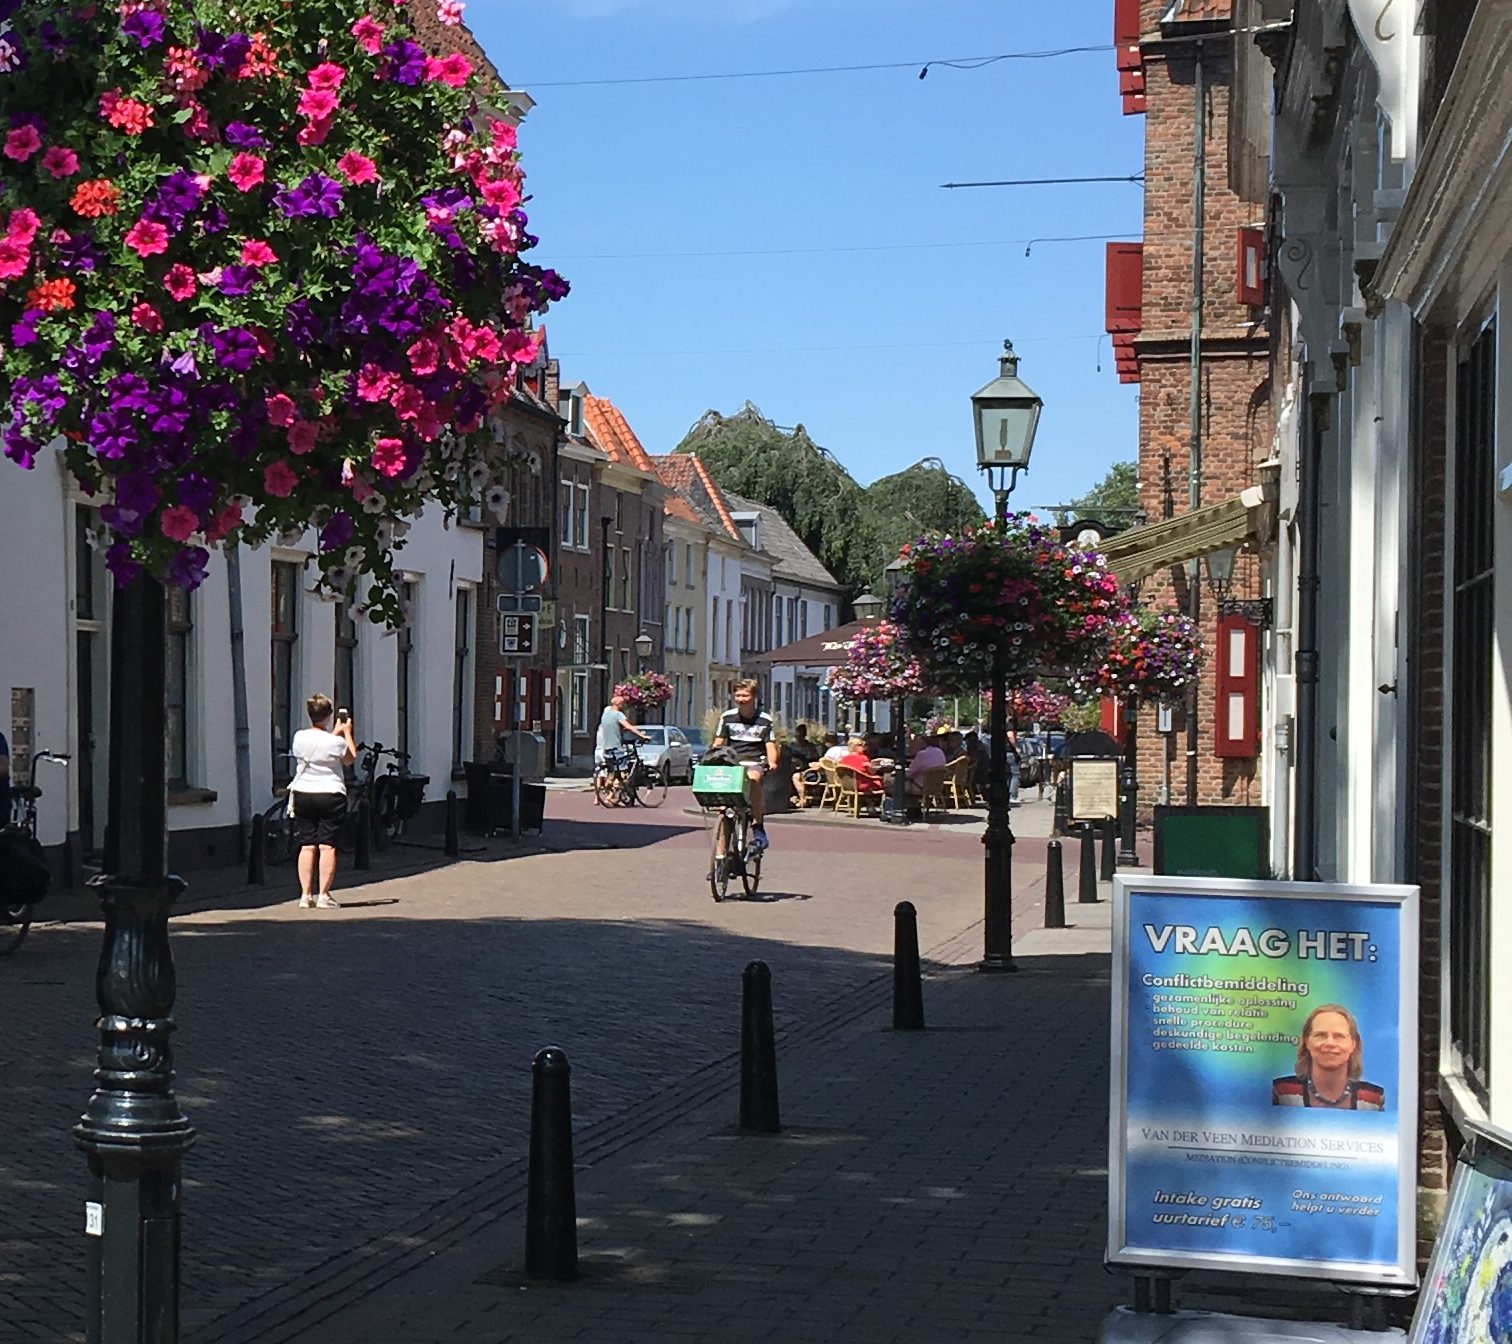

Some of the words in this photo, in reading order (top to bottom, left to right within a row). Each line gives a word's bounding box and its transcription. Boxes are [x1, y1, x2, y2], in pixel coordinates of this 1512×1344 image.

[1143, 924, 1291, 958] VRAAG
[1297, 929, 1379, 962] HET:
[1142, 973, 1310, 995] Conflictbemiddeling
[1153, 993, 1235, 1005] gezamenlijke
[1239, 997, 1297, 1009] oplossing
[1153, 1005, 1198, 1015] behoud
[1203, 1008, 1225, 1017] van
[1228, 1007, 1269, 1018] relatie
[1153, 1016, 1187, 1026] snelle
[1191, 1018, 1254, 1030] procedure
[1153, 1028, 1223, 1041] deskundige
[1226, 1030, 1299, 1045] begeleiding
[1153, 1040, 1208, 1051] gedeelde
[1212, 1042, 1253, 1053] kosten
[1141, 1128, 1169, 1141] VAN
[1173, 1130, 1198, 1143] DER
[1202, 1131, 1238, 1144] VEEN
[1241, 1133, 1319, 1149] MEDIATION
[1321, 1138, 1384, 1153] SERVICES
[1153, 1190, 1208, 1206] Intake
[1212, 1195, 1262, 1210] gratis
[1292, 1189, 1316, 1200] Ons
[1320, 1192, 1384, 1204] antwoord
[1291, 1201, 1324, 1213] helpt
[1327, 1205, 1334, 1213] u
[1339, 1205, 1381, 1216] verder
[1153, 1213, 1230, 1228] uurtarief
